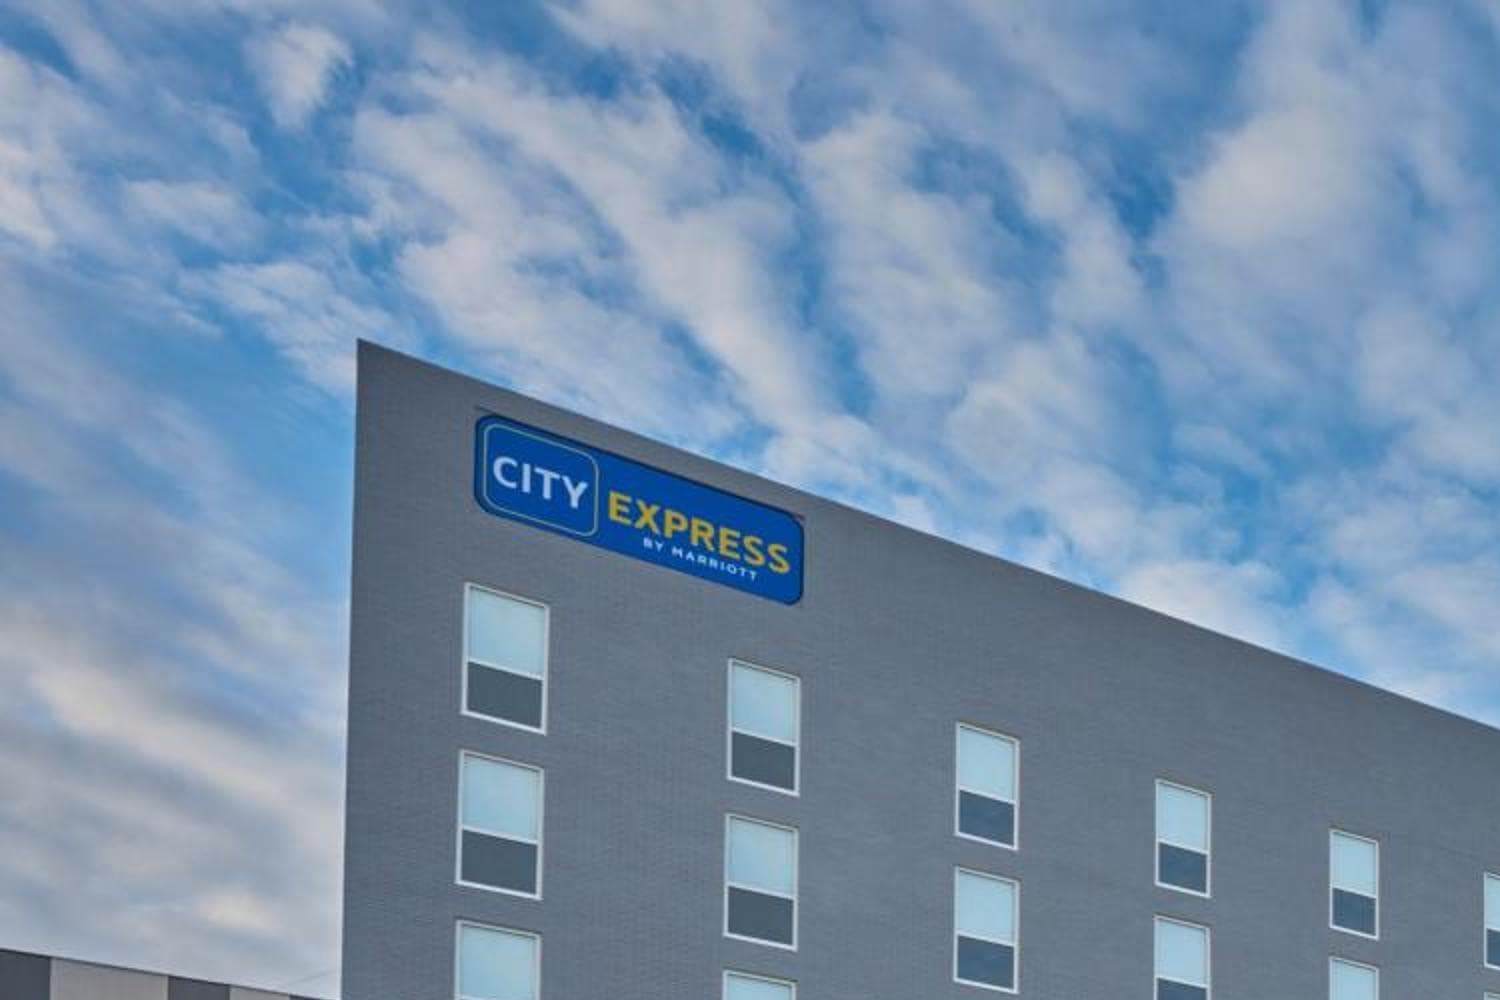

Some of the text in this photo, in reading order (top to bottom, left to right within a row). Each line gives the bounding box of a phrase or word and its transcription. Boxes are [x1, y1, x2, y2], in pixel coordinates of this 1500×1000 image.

[492, 456, 791, 575] CITY EXPRESS
[643, 537, 758, 582] BY MARRIOTT
